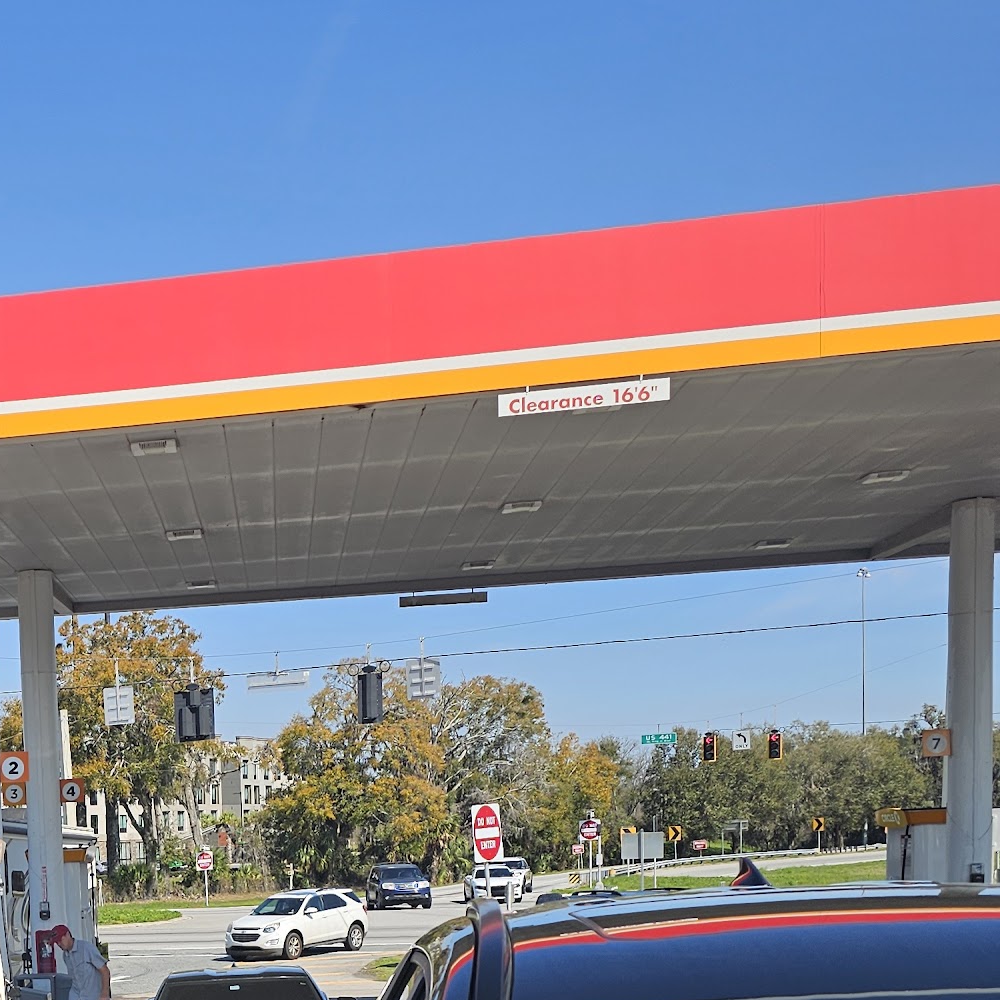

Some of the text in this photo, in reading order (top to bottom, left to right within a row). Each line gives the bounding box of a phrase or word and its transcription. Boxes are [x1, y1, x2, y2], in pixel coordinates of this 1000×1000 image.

[508, 385, 658, 414] Clearance 16'6"
[932, 737, 941, 749] 7
[8, 761, 19, 775] 2
[10, 788, 18, 799] 3
[66, 785, 76, 797] 4
[477, 816, 496, 826] DO NOT
[480, 840, 496, 850] ENTER
